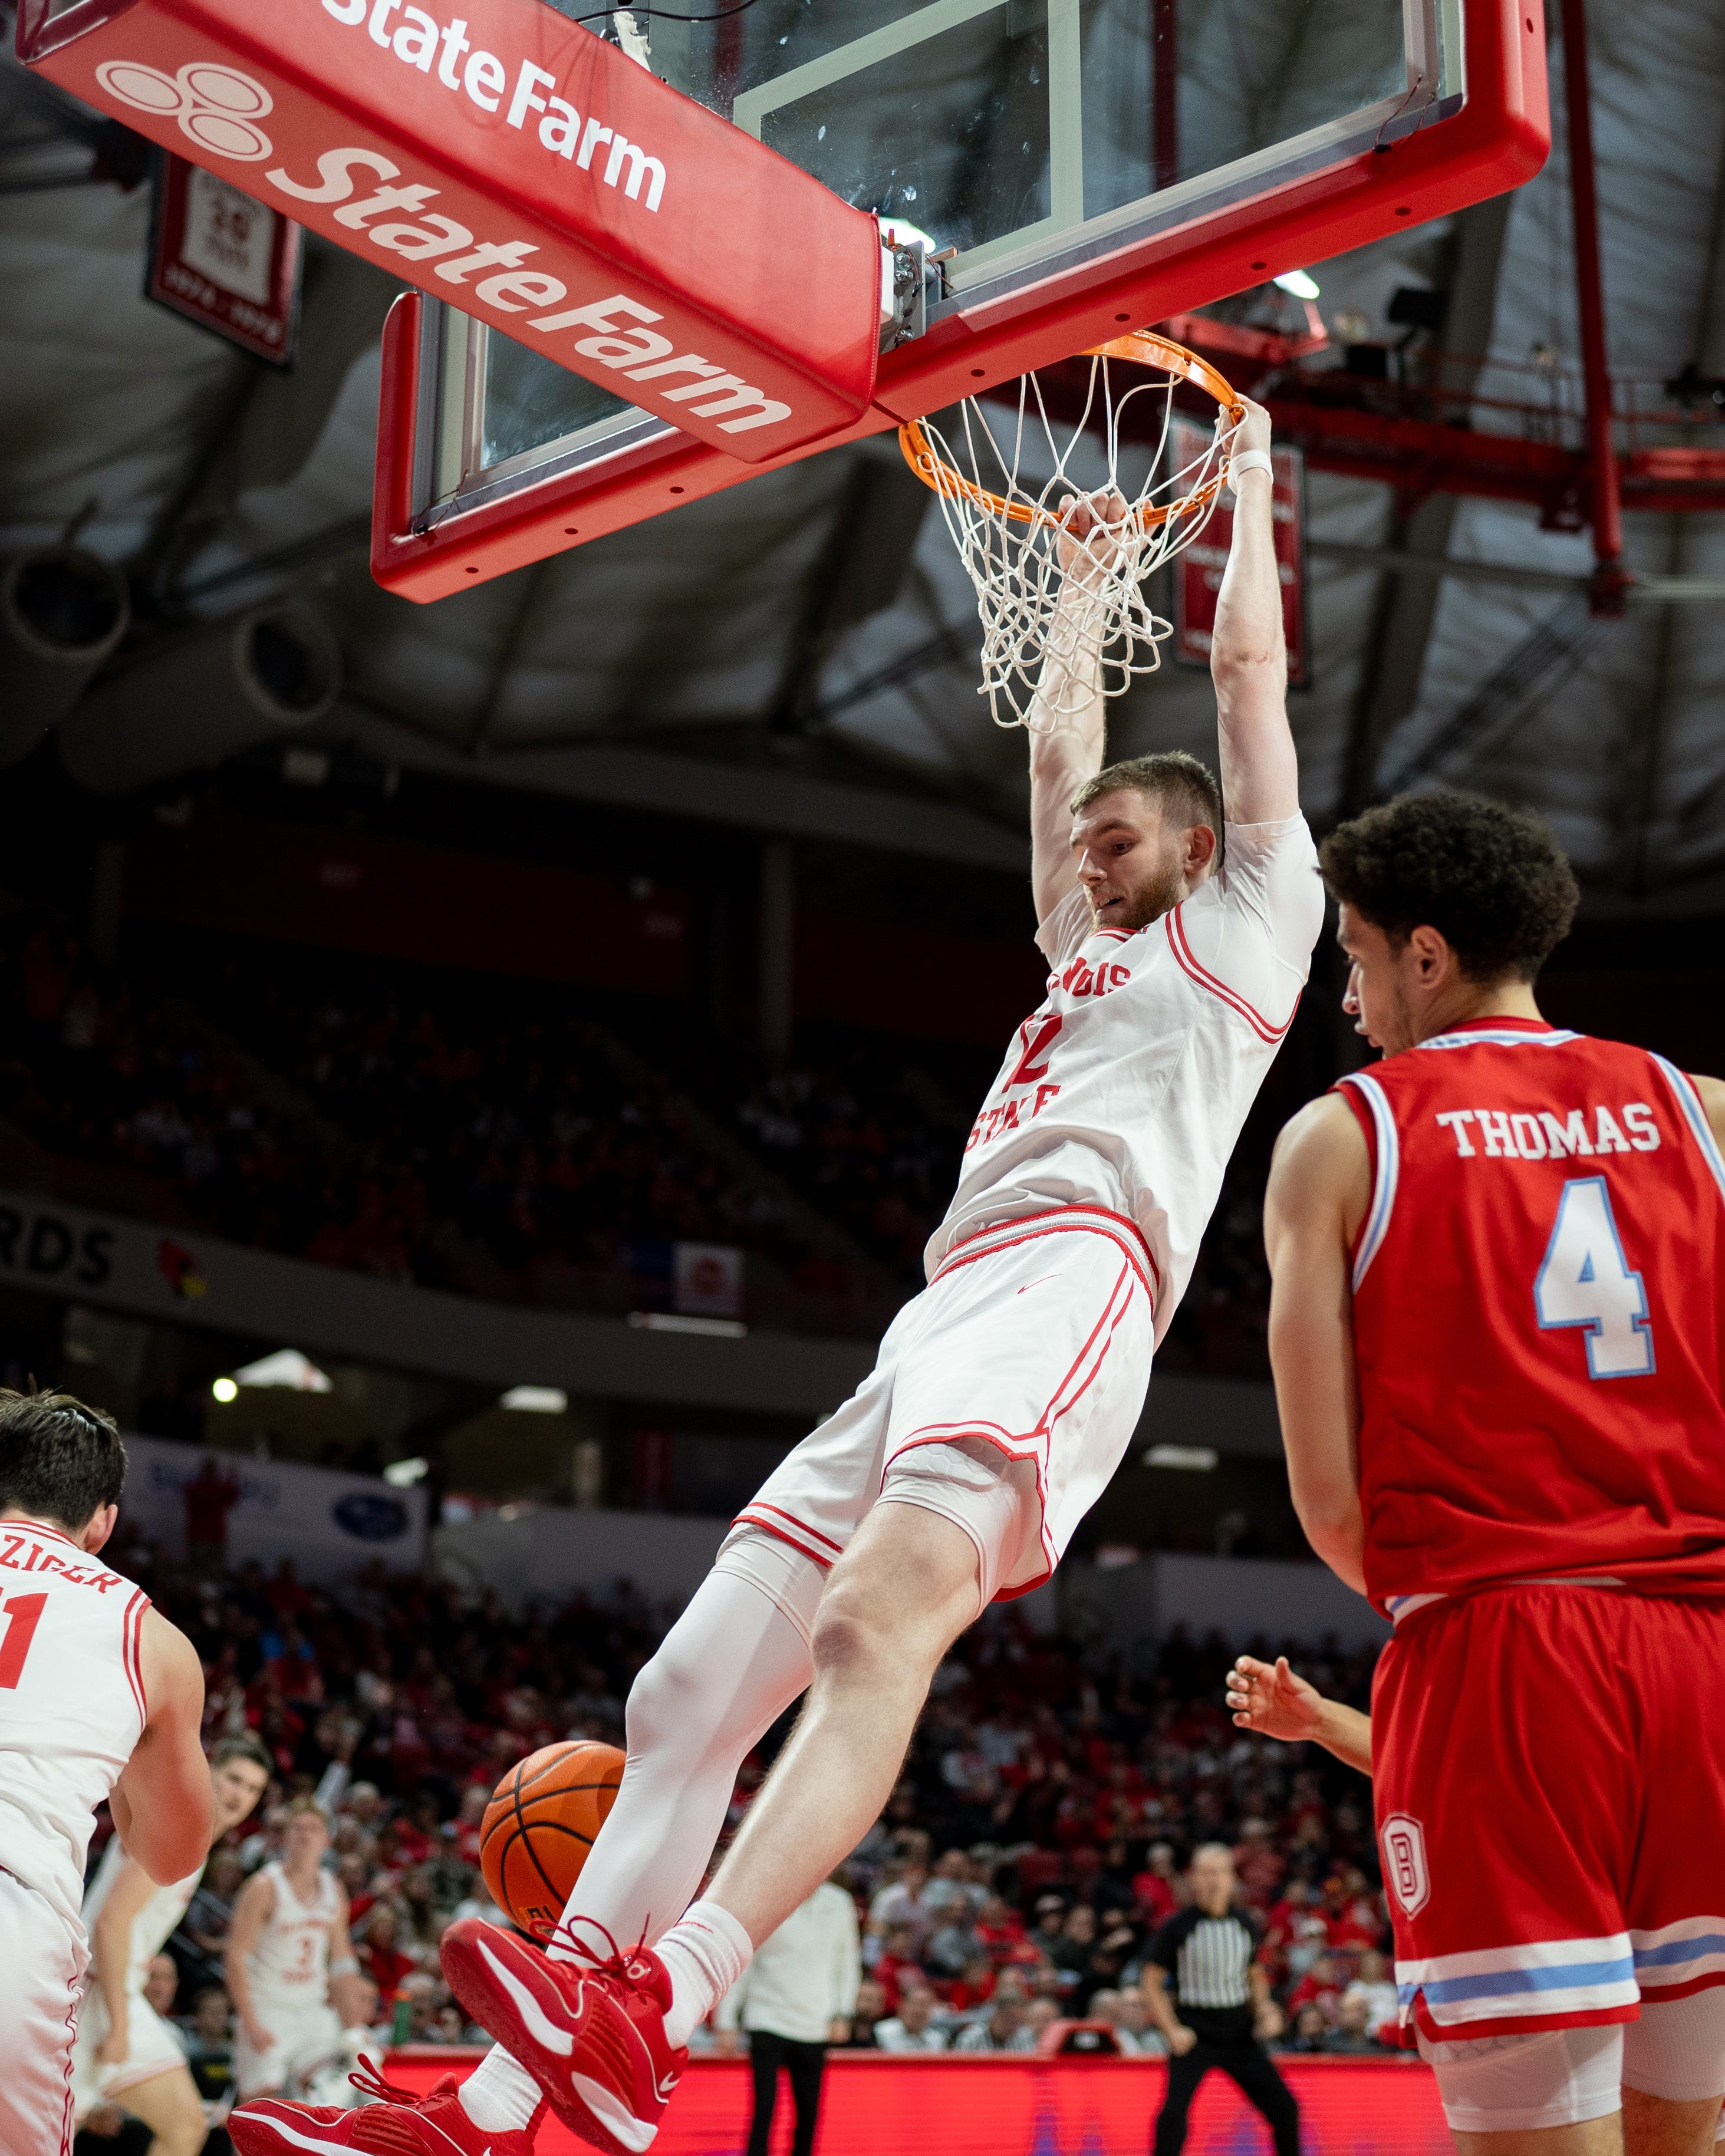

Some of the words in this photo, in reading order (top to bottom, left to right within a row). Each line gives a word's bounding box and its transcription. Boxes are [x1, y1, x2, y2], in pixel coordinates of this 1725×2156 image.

[1436, 1103, 1661, 1160] THOMAS
[1533, 1175, 1657, 1380] 4
[0, 1587, 49, 1690] 1
